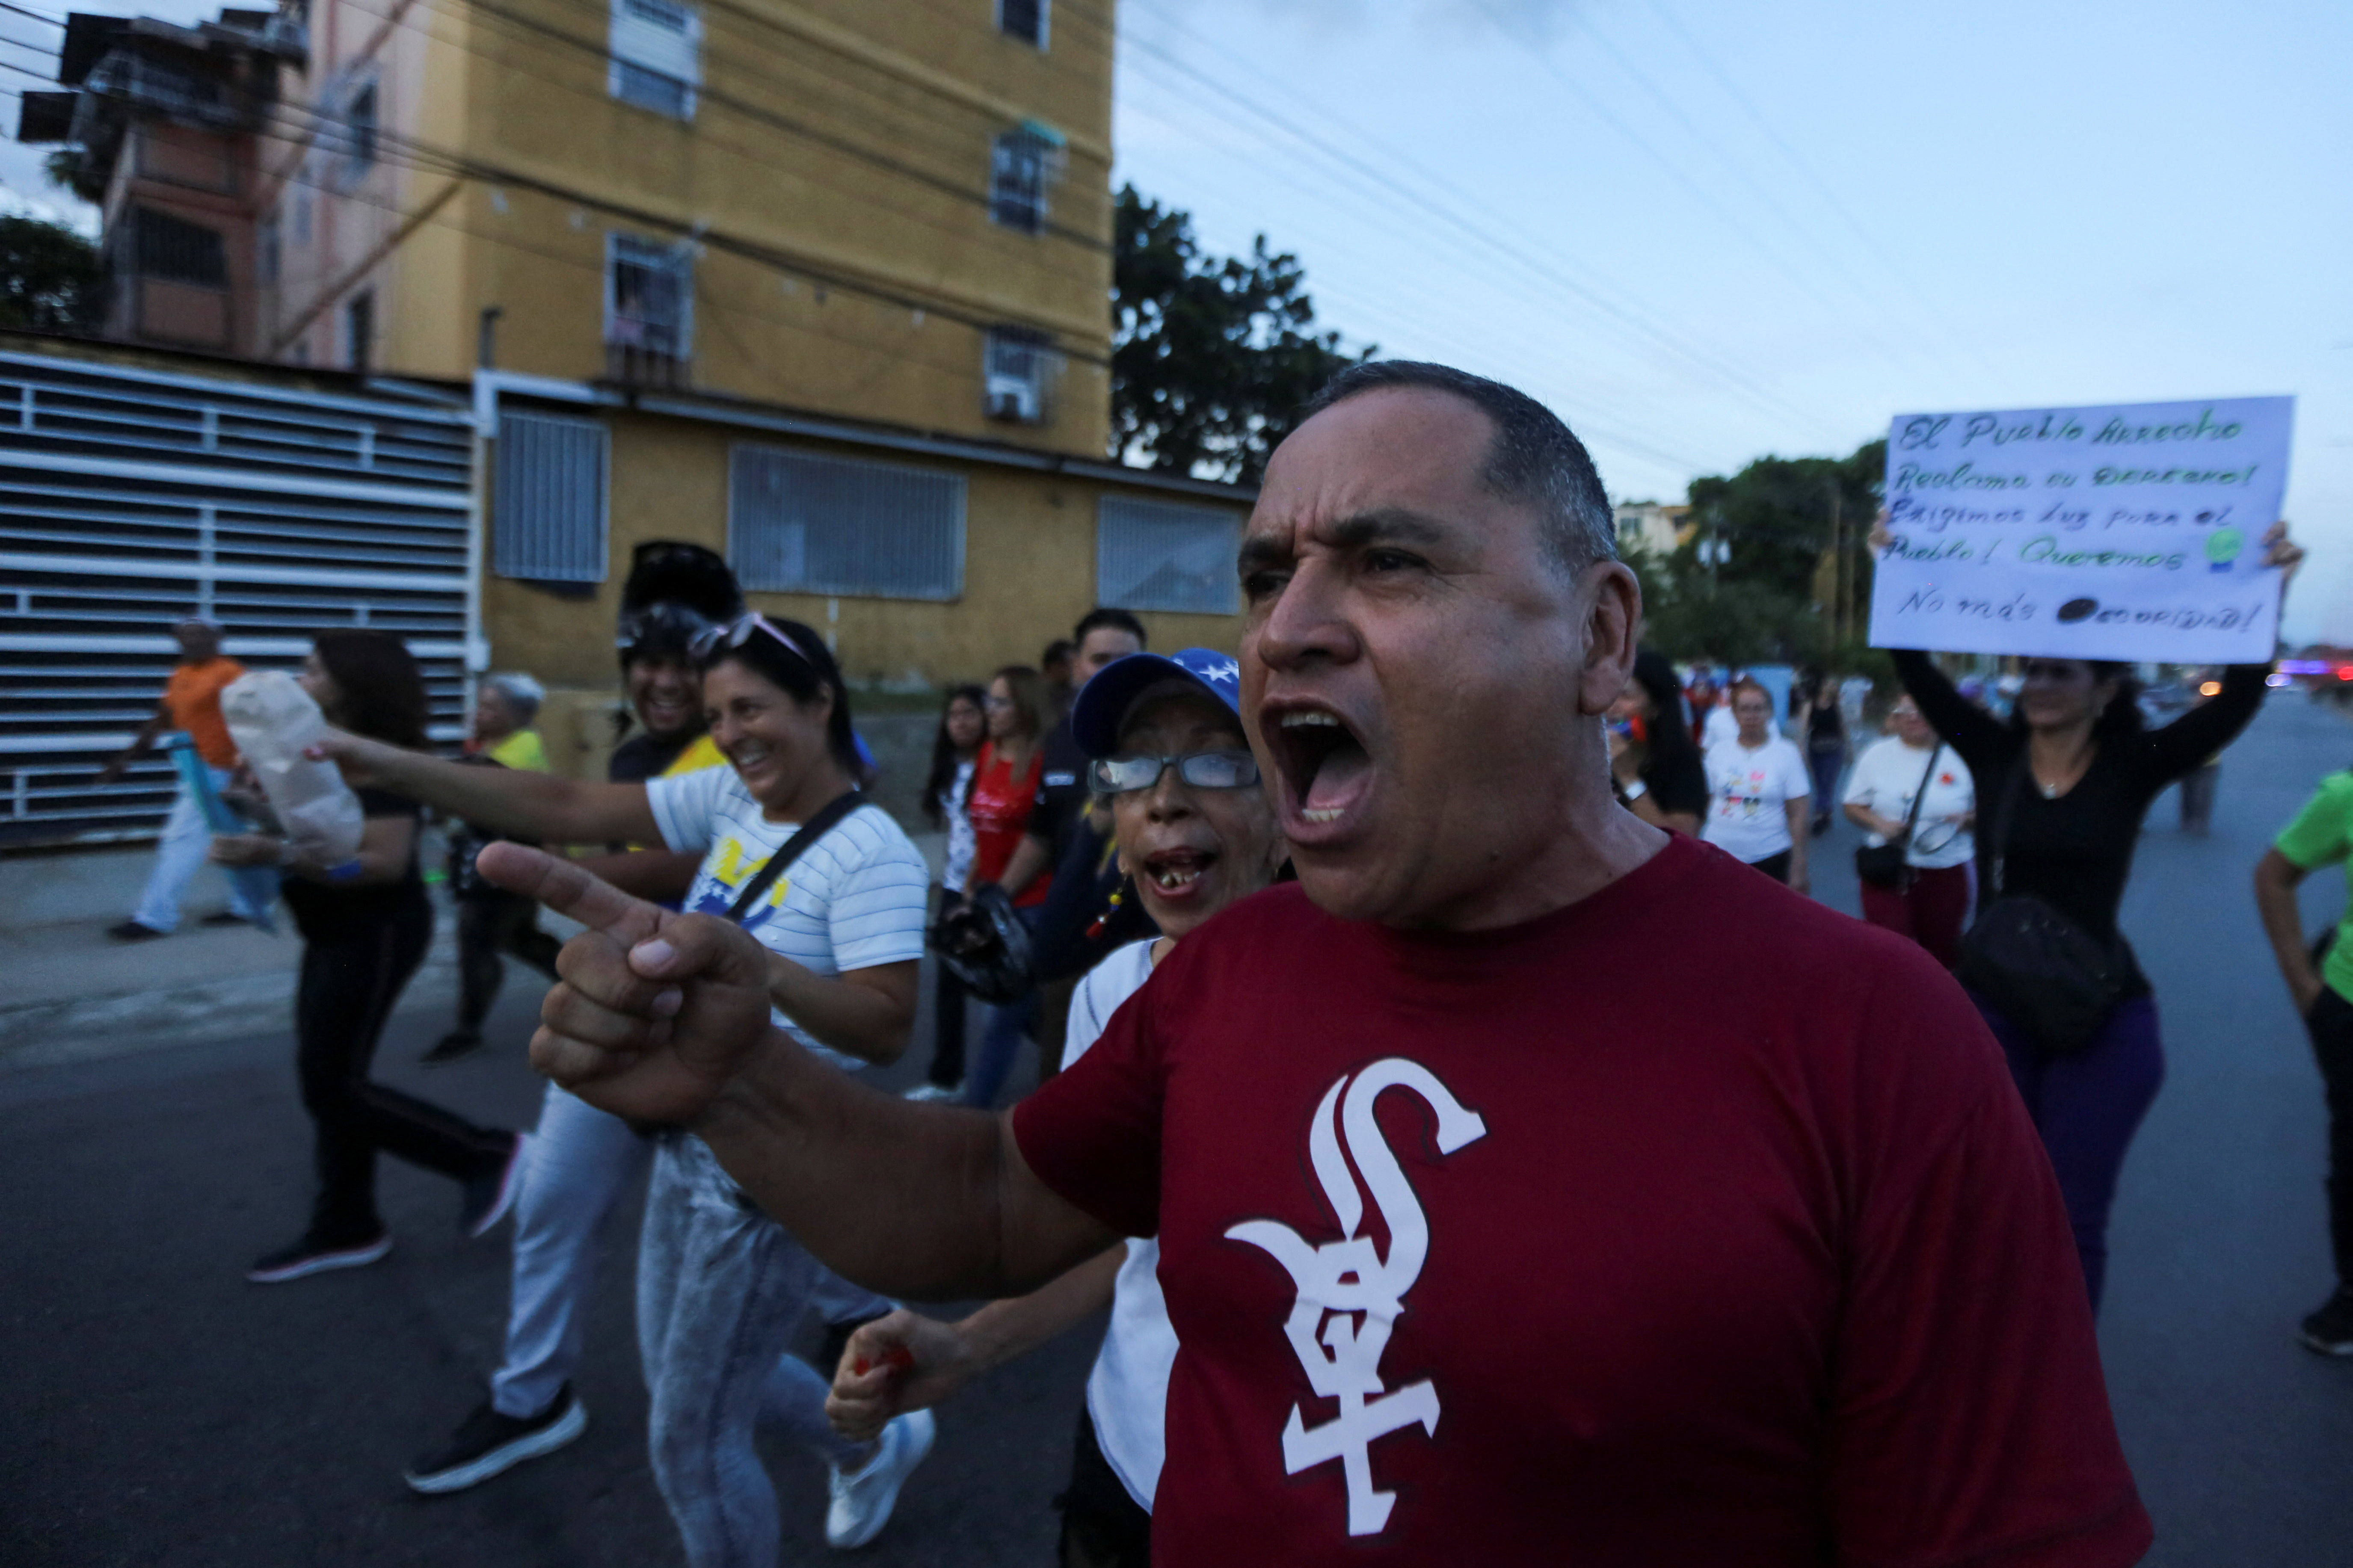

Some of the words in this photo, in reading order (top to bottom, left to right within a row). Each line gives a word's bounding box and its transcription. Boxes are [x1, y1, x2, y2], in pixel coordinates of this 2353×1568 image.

[1899, 415, 1952, 450] El
[1960, 412, 2083, 447] Pueblo
[1898, 587, 1943, 615] No
[1959, 592, 2036, 621] más
